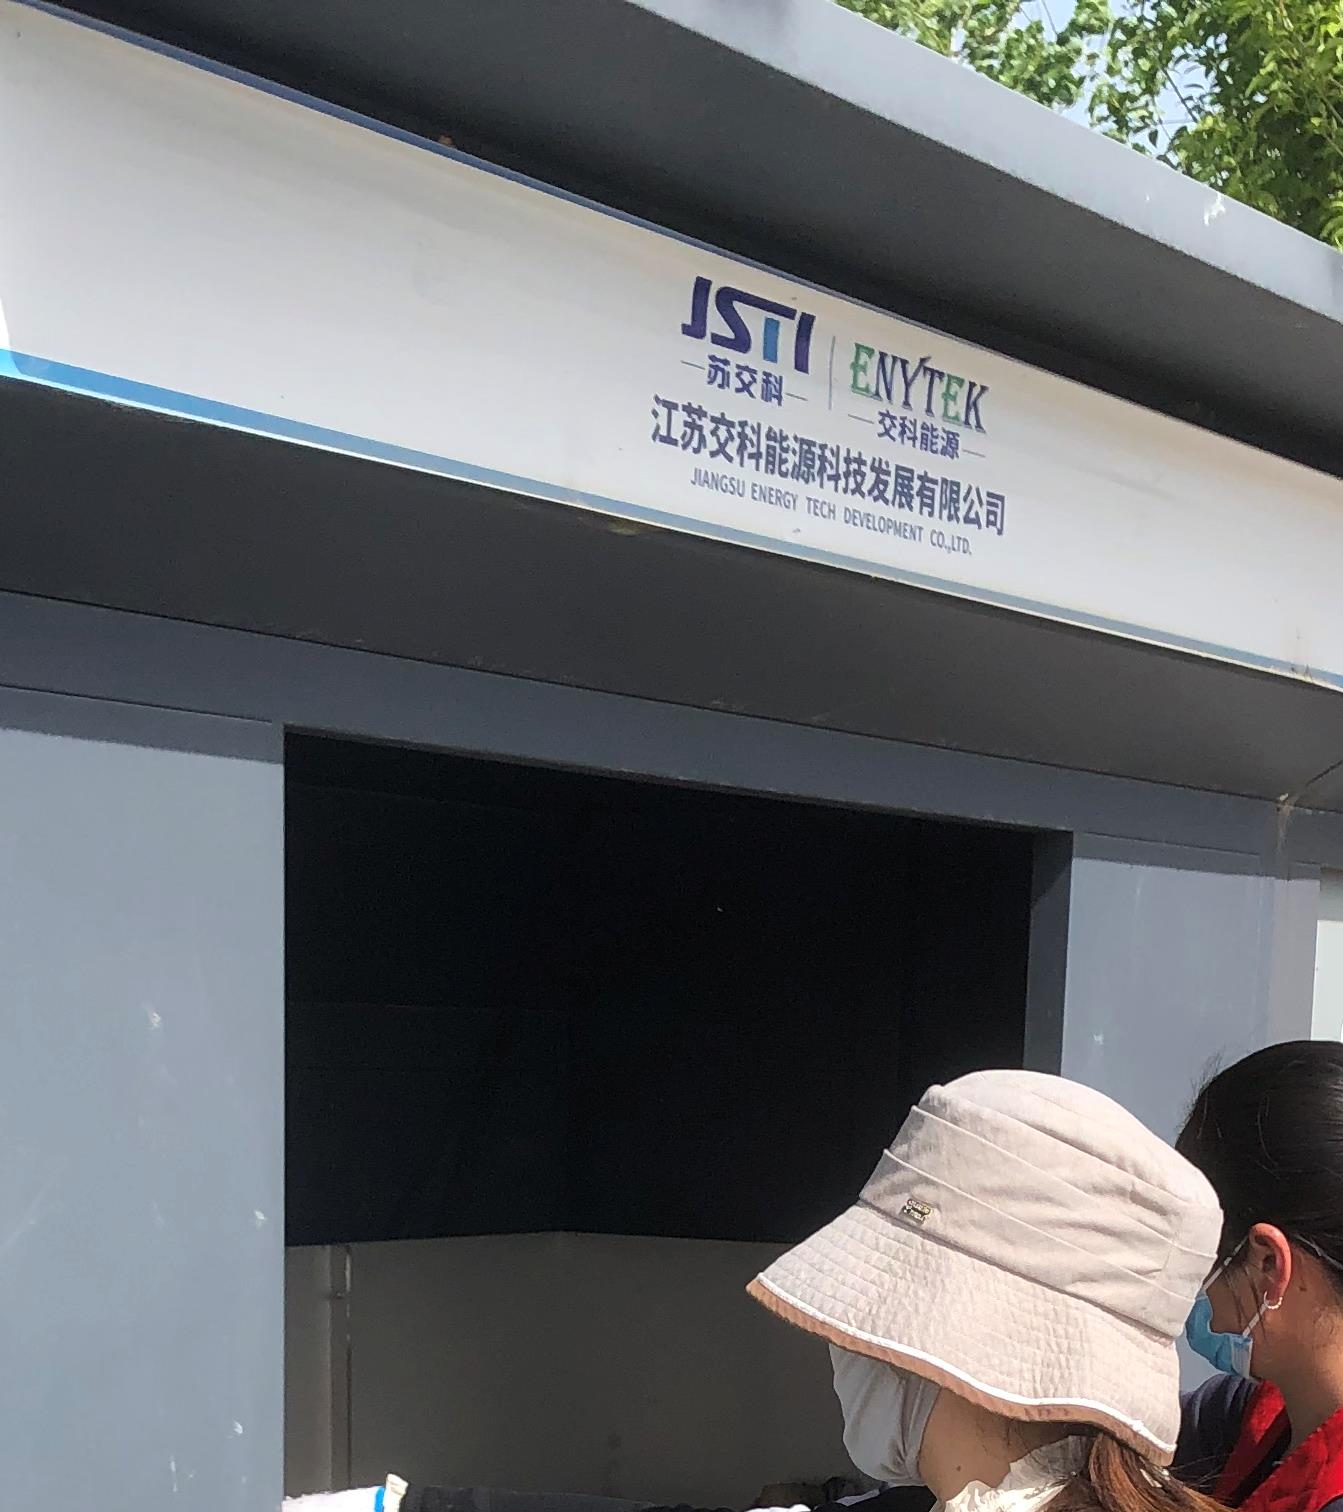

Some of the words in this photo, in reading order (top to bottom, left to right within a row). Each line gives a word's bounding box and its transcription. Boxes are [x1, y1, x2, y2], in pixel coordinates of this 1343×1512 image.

[707, 353, 785, 406] 苏交科
[850, 341, 989, 434] ENYTEK
[651, 394, 1007, 536] 江苏交科能源科技发展有限公司
[877, 409, 960, 460] 交科能源
[690, 466, 746, 498] JIANGSU
[751, 483, 798, 511] ENERGY
[806, 496, 836, 521] TECH
[844, 505, 923, 543] DEVELOPMENT
